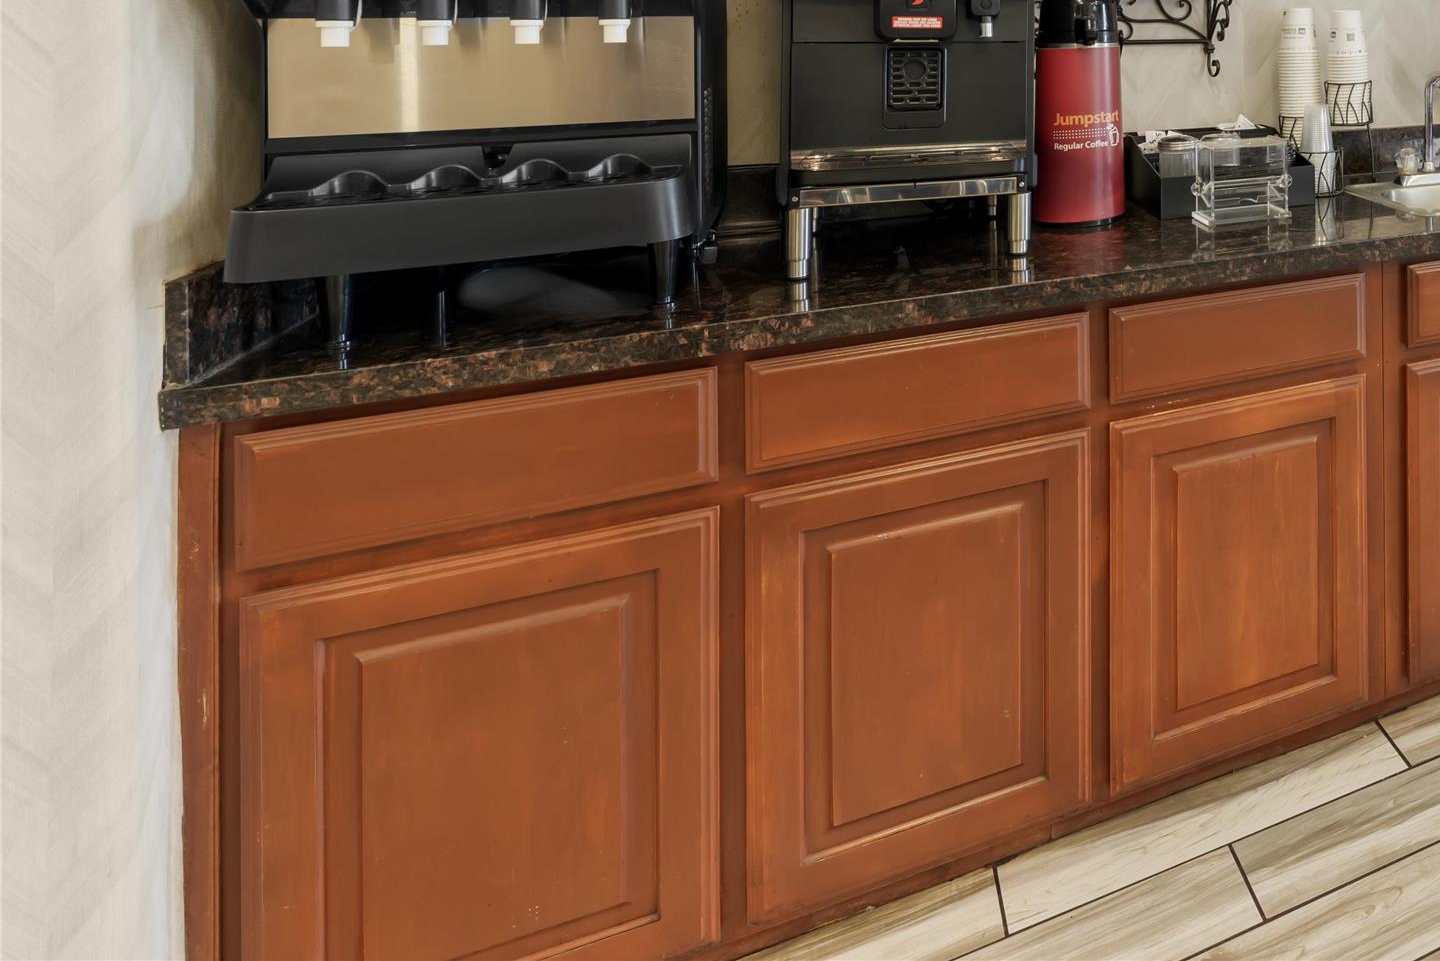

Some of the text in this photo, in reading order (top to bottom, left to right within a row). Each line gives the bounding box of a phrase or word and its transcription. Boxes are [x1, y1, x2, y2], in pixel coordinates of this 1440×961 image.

[1053, 109, 1119, 128] Jumpstart
[1054, 140, 1109, 152] Regular Coffee
